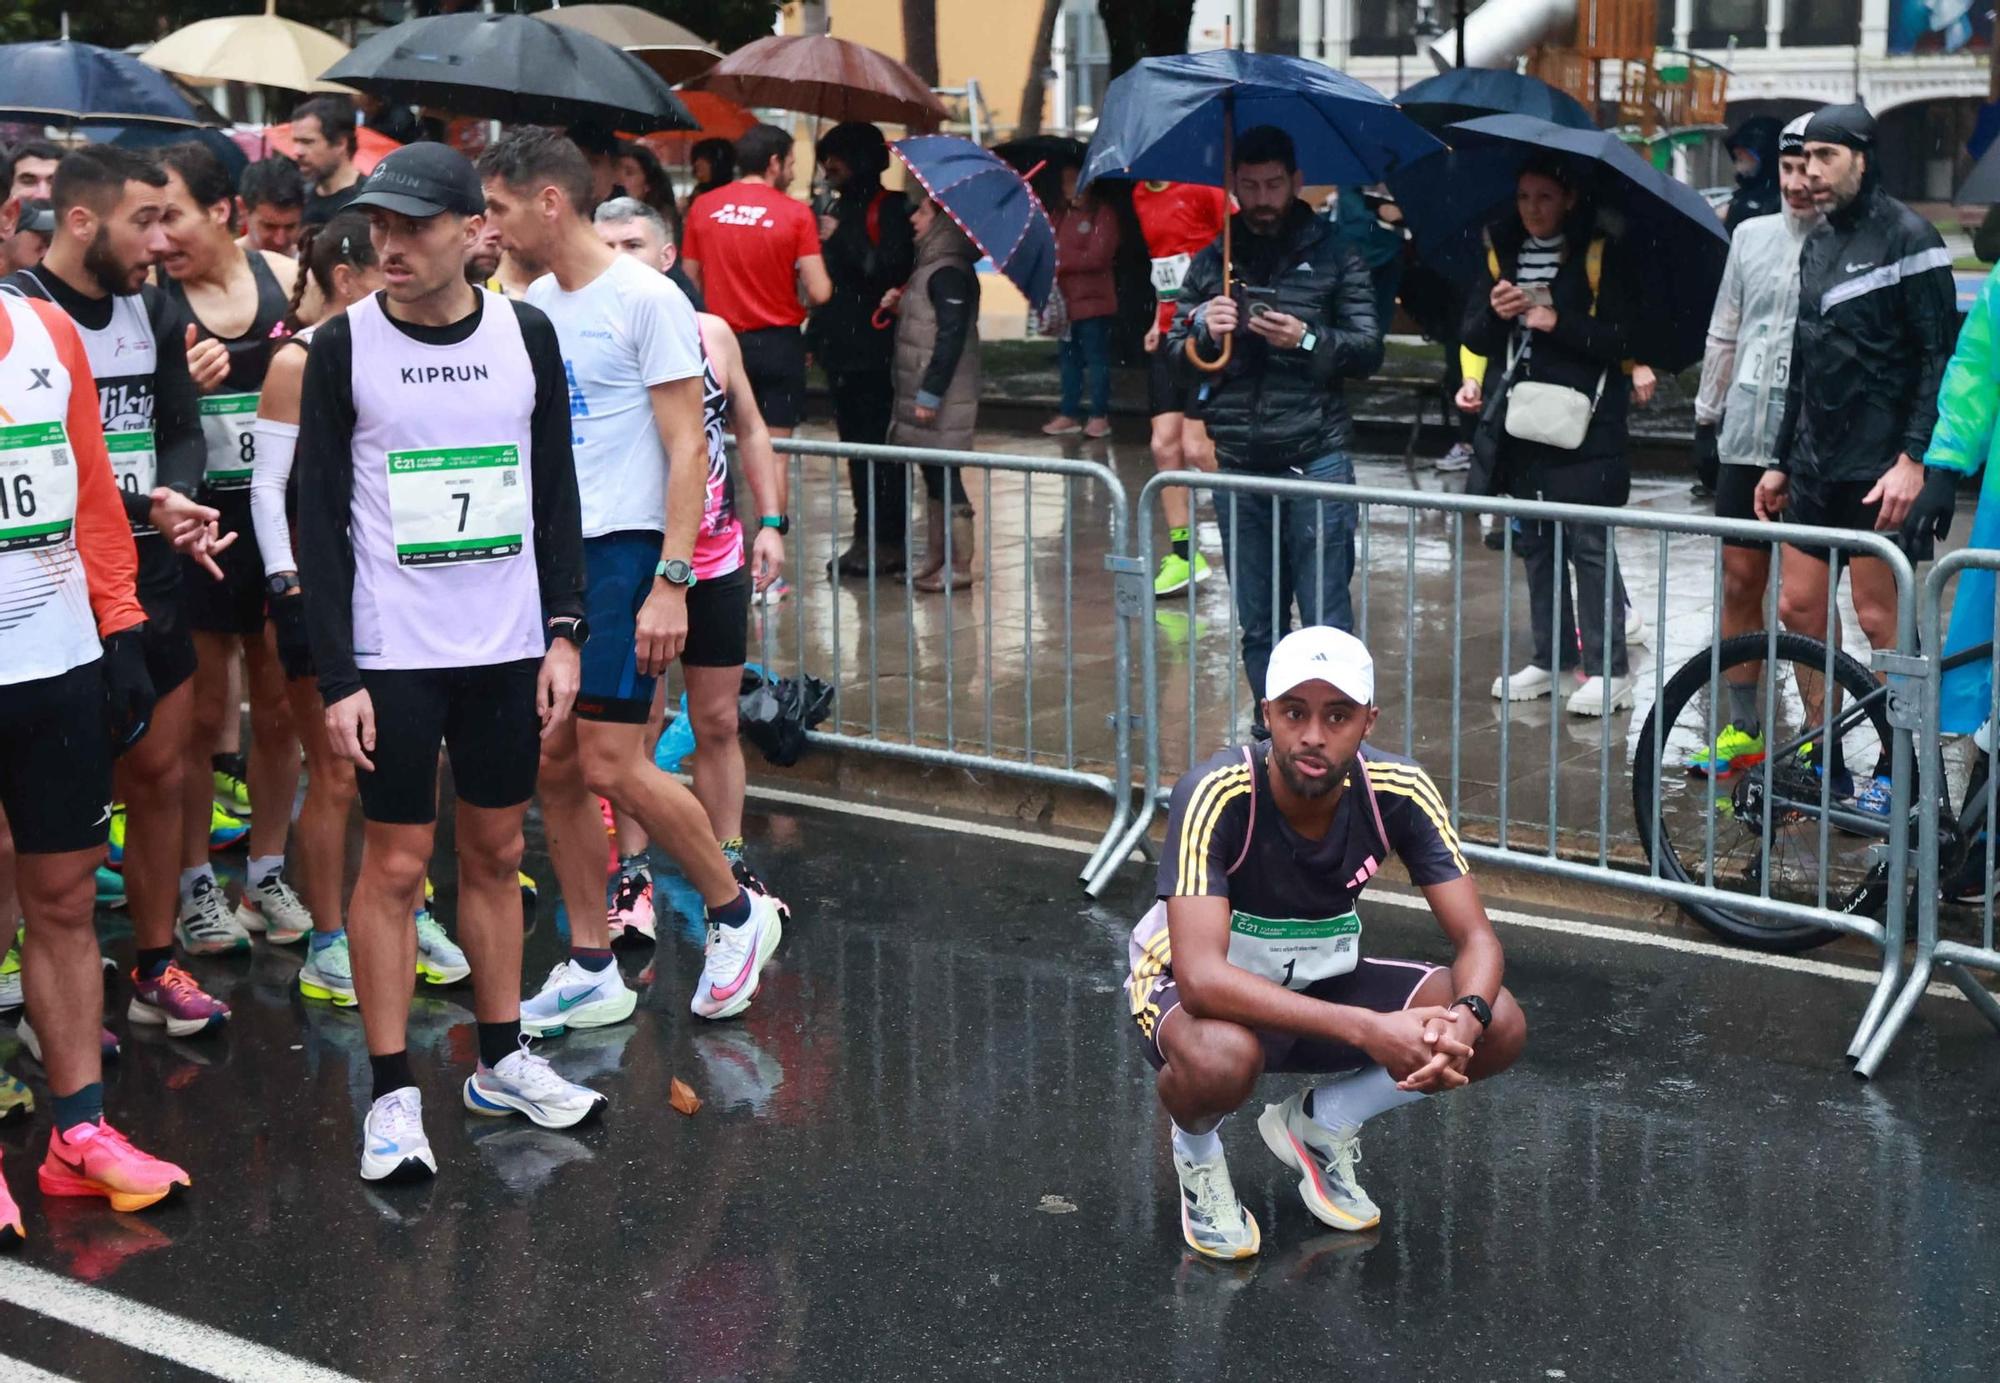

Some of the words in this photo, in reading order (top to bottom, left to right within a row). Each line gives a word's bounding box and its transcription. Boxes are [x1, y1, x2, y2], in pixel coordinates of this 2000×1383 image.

[401, 364, 489, 384] KIPRUN
[1753, 353, 1788, 382] 25
[451, 492, 470, 533] 7
[1281, 958, 1296, 987] 1
